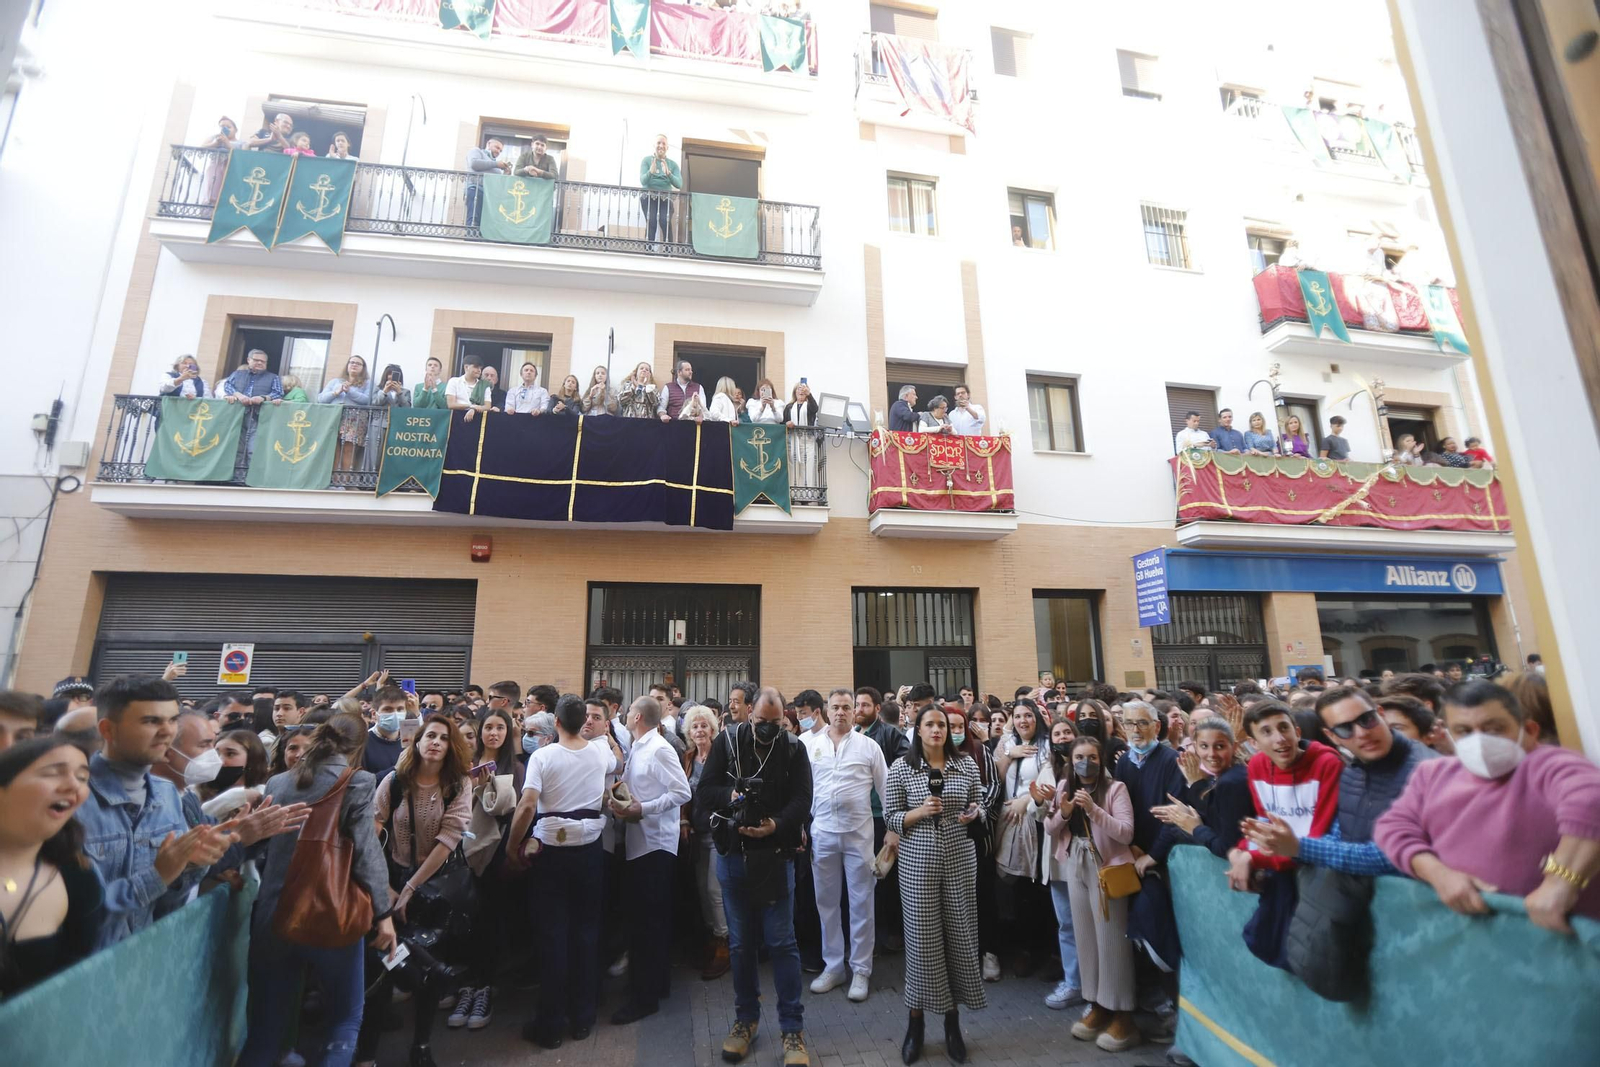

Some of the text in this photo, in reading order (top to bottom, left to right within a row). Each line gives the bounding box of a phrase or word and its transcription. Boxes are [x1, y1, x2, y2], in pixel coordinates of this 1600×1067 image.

[406, 417, 431, 427] SPES
[395, 432, 437, 443] NOSTRA
[386, 446, 443, 458] CORONATA
[930, 444, 964, 459] SPQR
[1144, 566, 1164, 579] Huelva
[1386, 565, 1451, 587] Allianz
